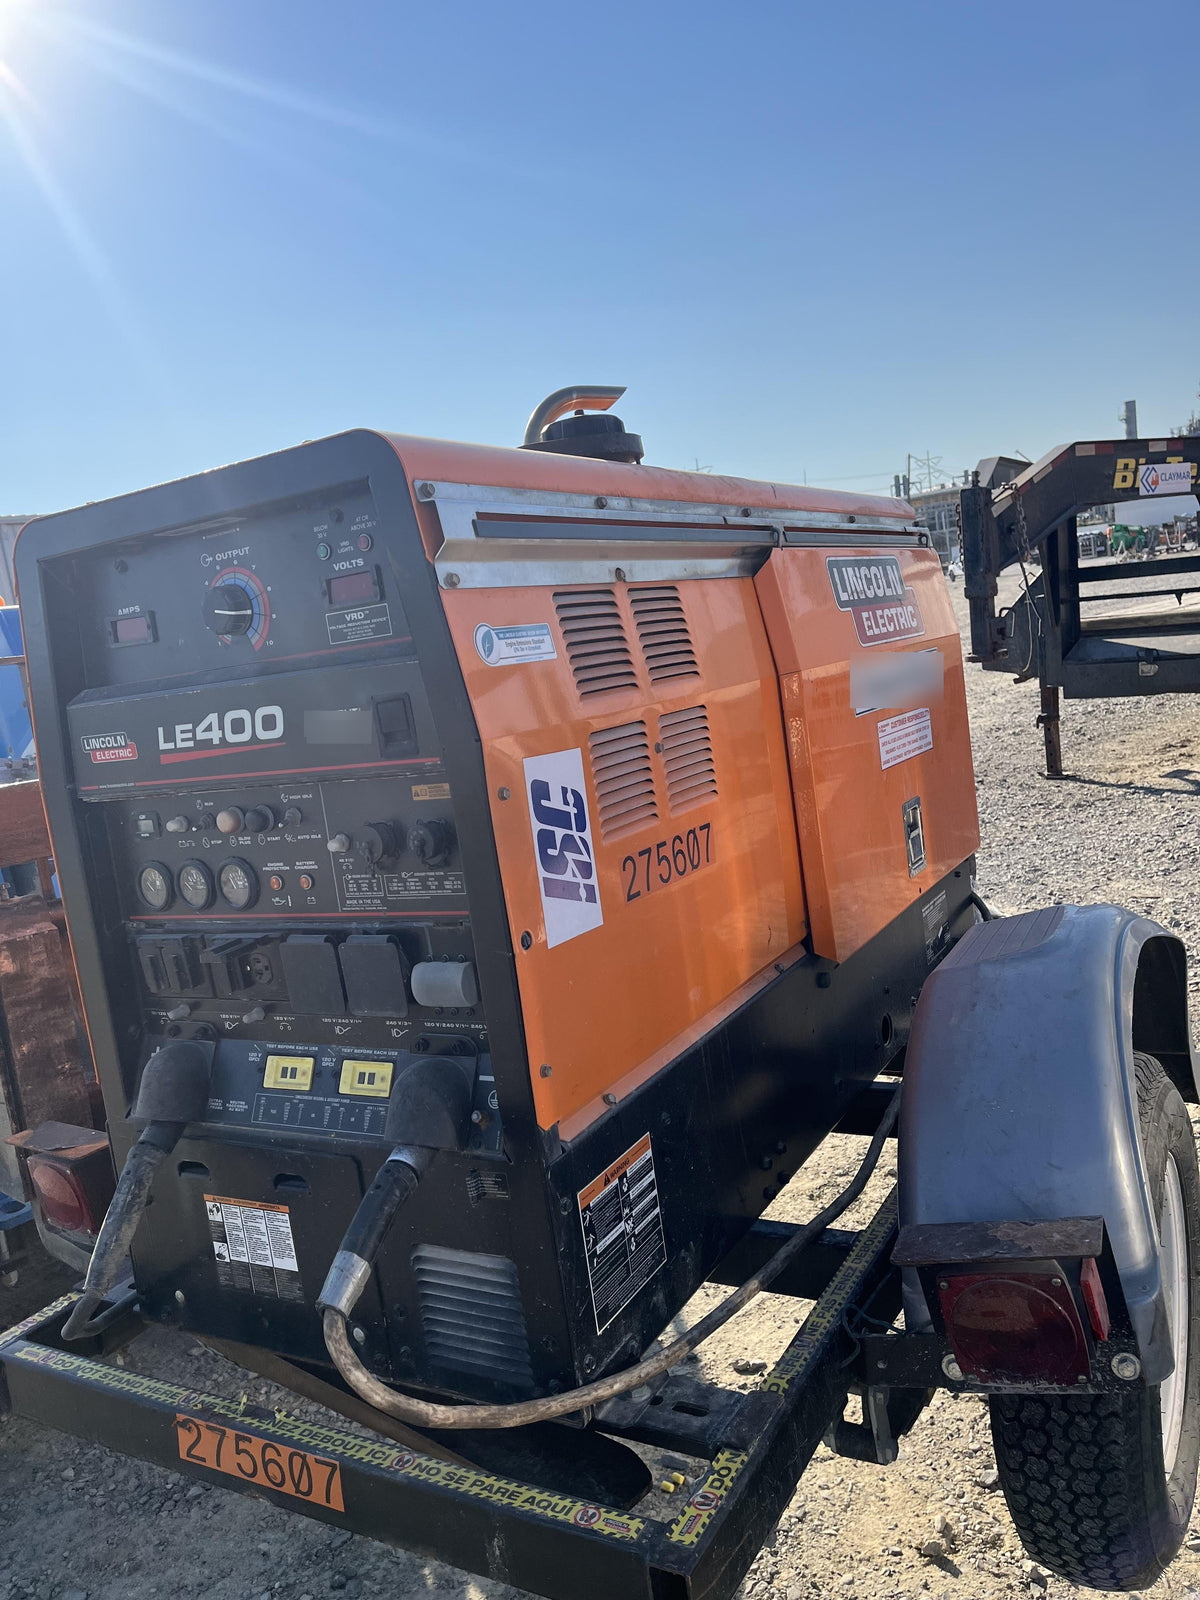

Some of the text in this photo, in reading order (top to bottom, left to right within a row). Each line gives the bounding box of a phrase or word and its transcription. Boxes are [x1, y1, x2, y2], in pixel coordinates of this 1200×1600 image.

[215, 546, 250, 562] OUTPUT
[333, 558, 364, 572] VOLTS
[832, 565, 903, 602] LINCOLN
[117, 605, 141, 616] AMPS
[861, 605, 918, 636] ELECTRIC
[157, 705, 285, 751] LE400
[83, 735, 126, 751] LINCOLN
[95, 748, 133, 760] ELECTRIC
[610, 1157, 630, 1178] WARNING
[817, 1298, 838, 1319] PAS
[830, 1265, 858, 1296] TENEZ
[773, 1351, 805, 1380] HERE
[53, 1358, 72, 1368] DO
[98, 1372, 143, 1389] STAND
[142, 1384, 183, 1400] HERE
[298, 1428, 365, 1454] DEBOUT
[366, 1448, 391, 1462] ICI
[412, 1462, 576, 1517] NO SE PARE AQUÍ
[708, 1466, 732, 1490] DO
[603, 1517, 630, 1529] LINCOLN
